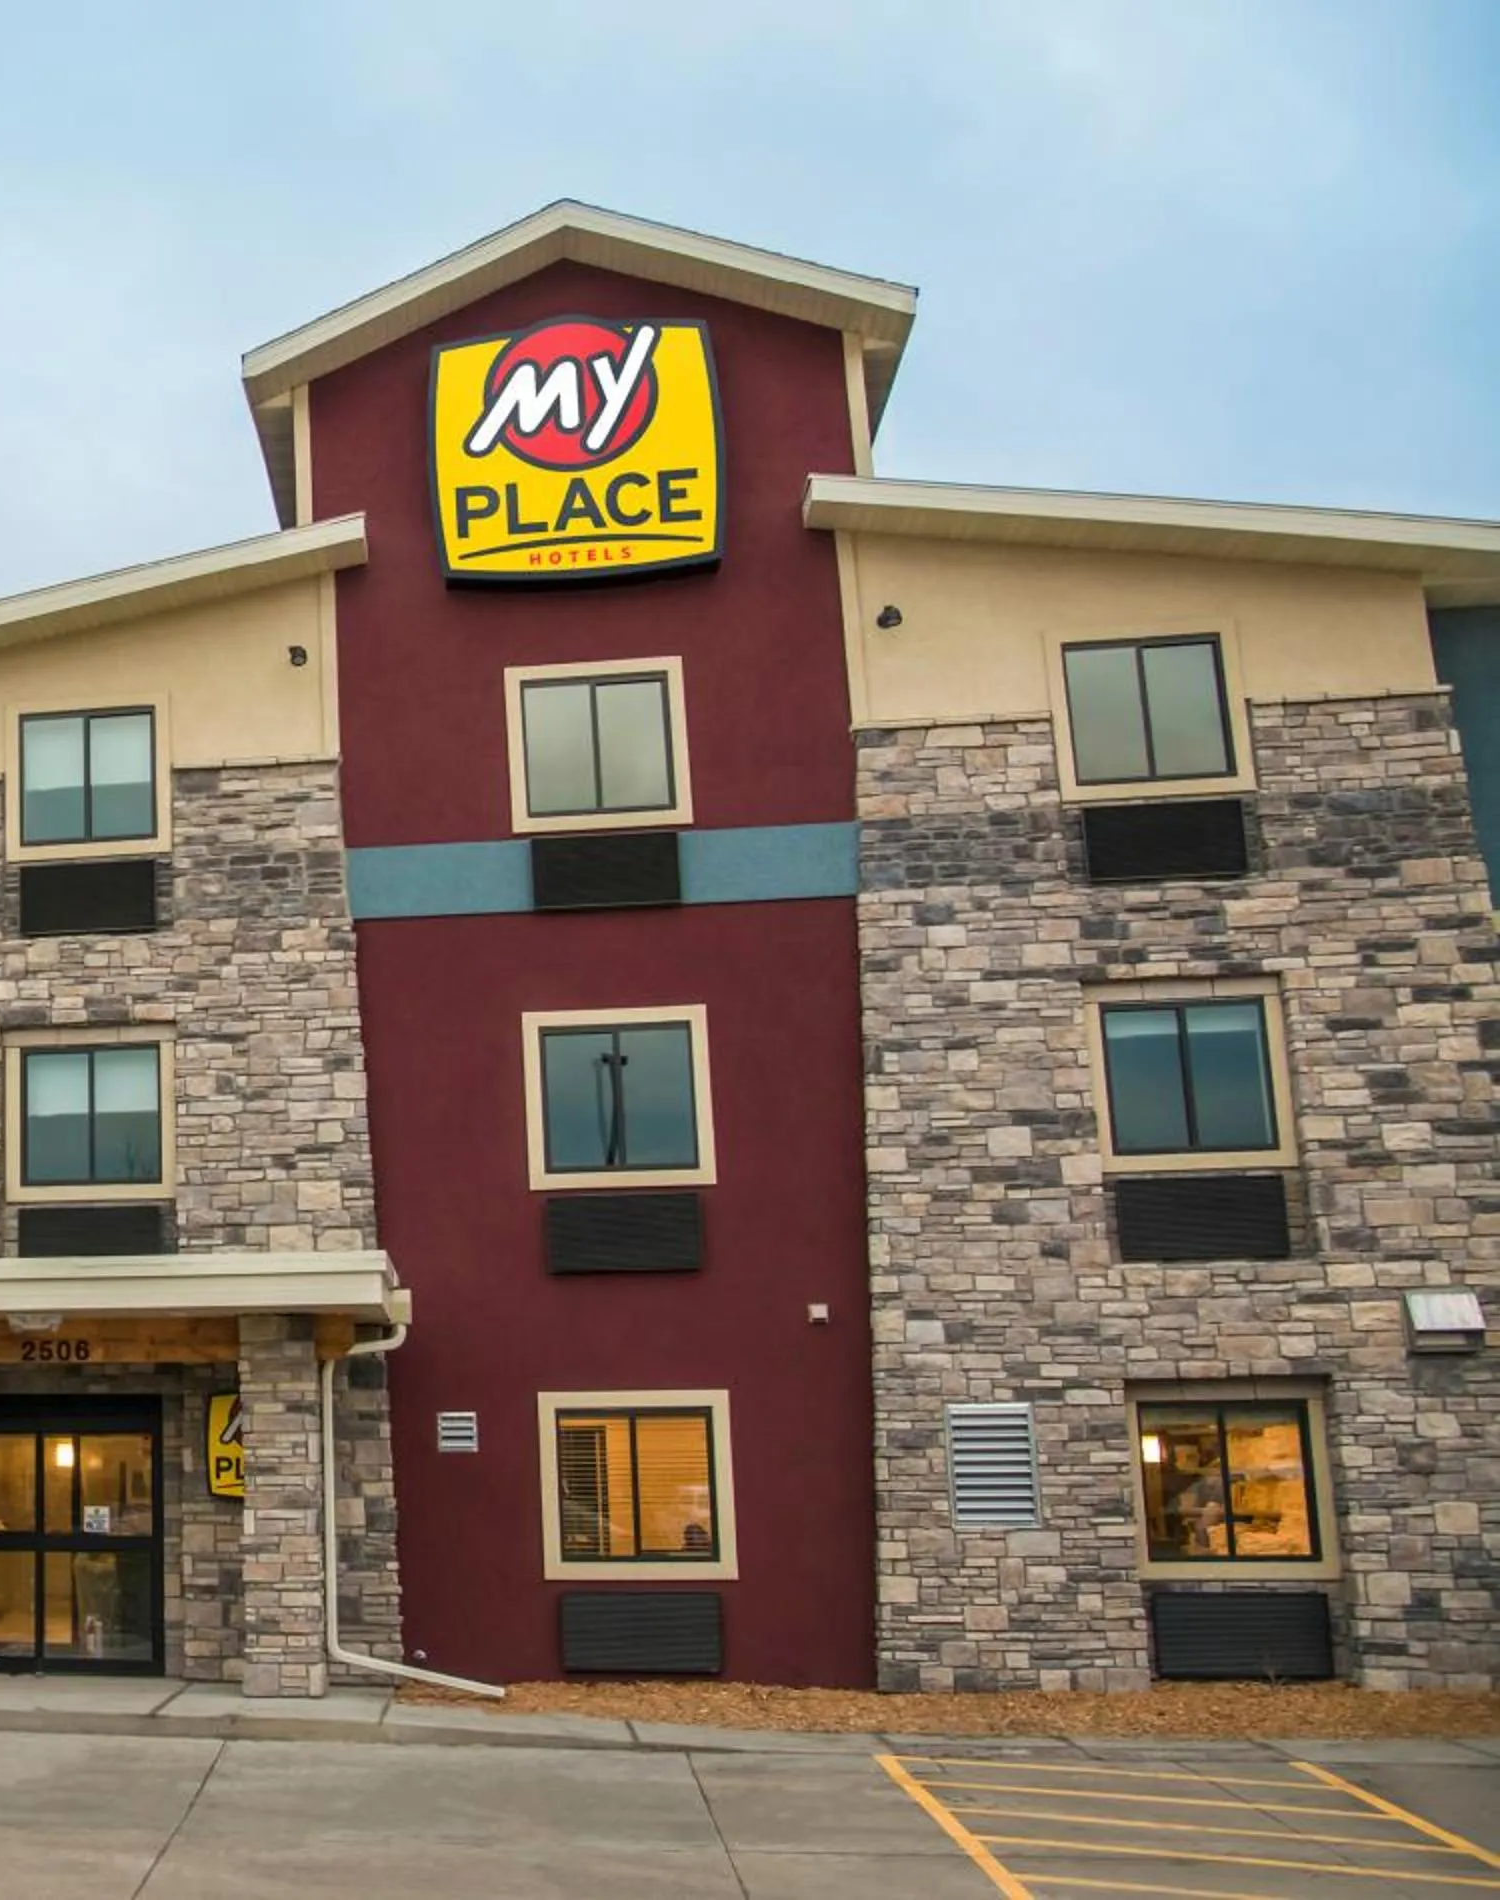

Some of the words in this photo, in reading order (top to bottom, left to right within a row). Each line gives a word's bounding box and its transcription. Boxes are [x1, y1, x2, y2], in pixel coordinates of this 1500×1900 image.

[454, 467, 703, 540] PLACE
[529, 547, 632, 566] HOTELS
[21, 1340, 90, 1361] 2506
